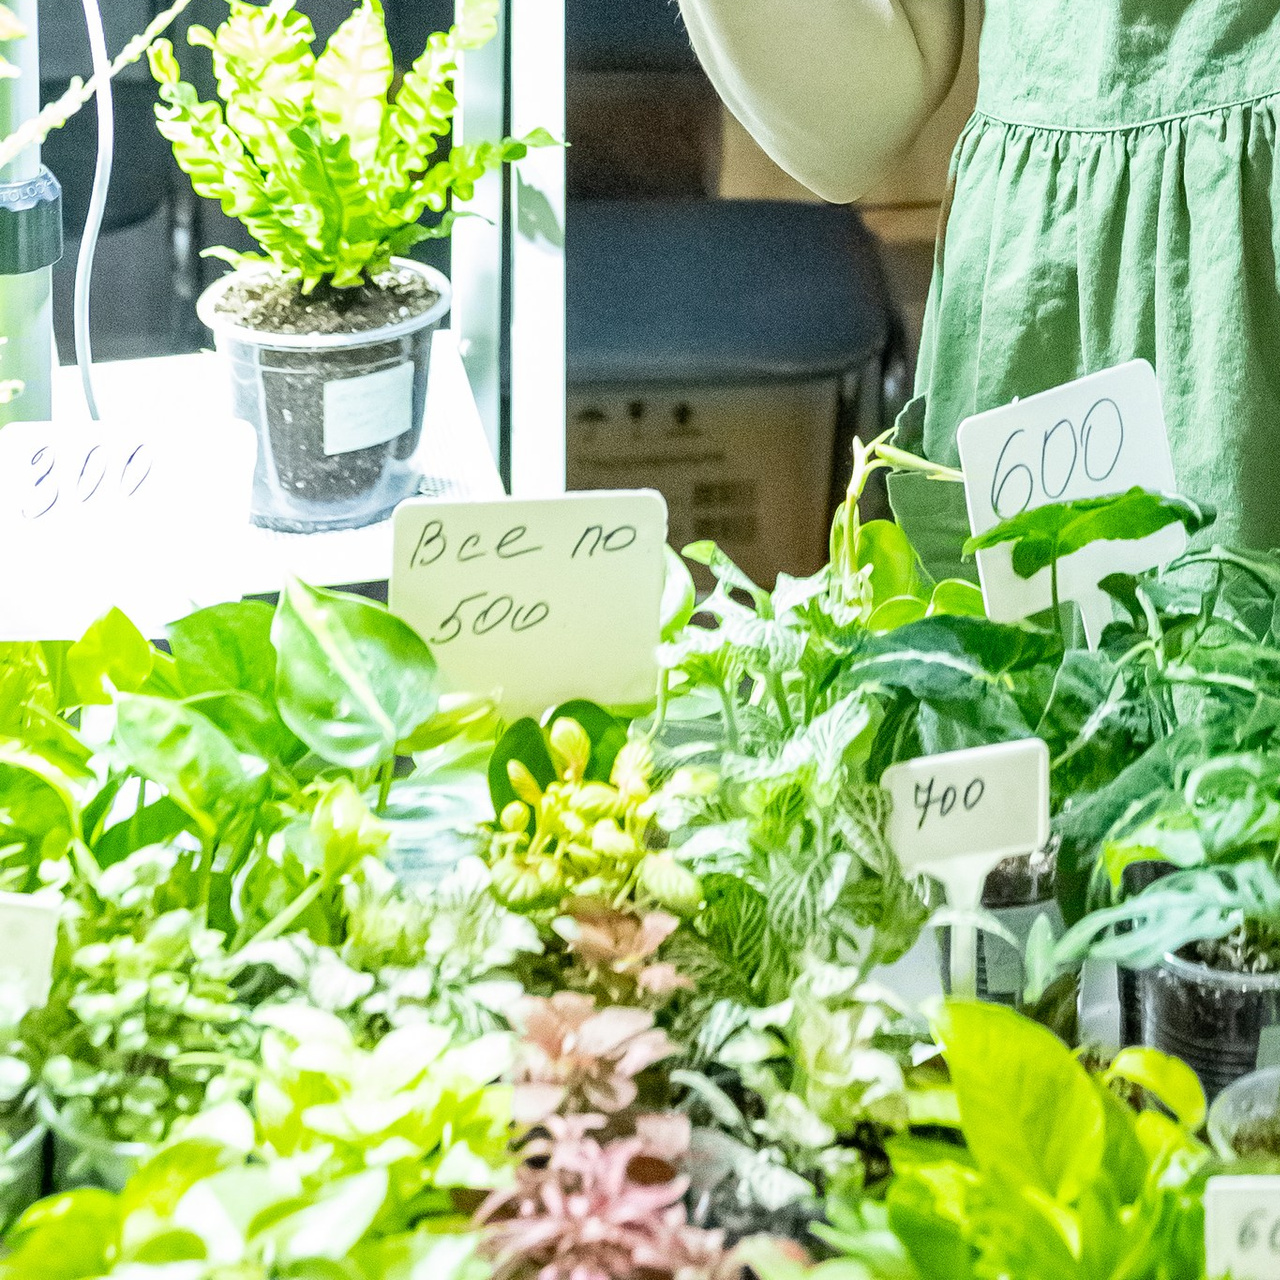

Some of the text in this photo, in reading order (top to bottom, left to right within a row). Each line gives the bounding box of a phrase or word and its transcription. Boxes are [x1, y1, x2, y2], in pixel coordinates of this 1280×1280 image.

[21, 442, 154, 520] 300
[990, 397, 1124, 519] 600
[569, 520, 638, 559] по
[430, 591, 551, 646] 500
[913, 775, 987, 831] 700
